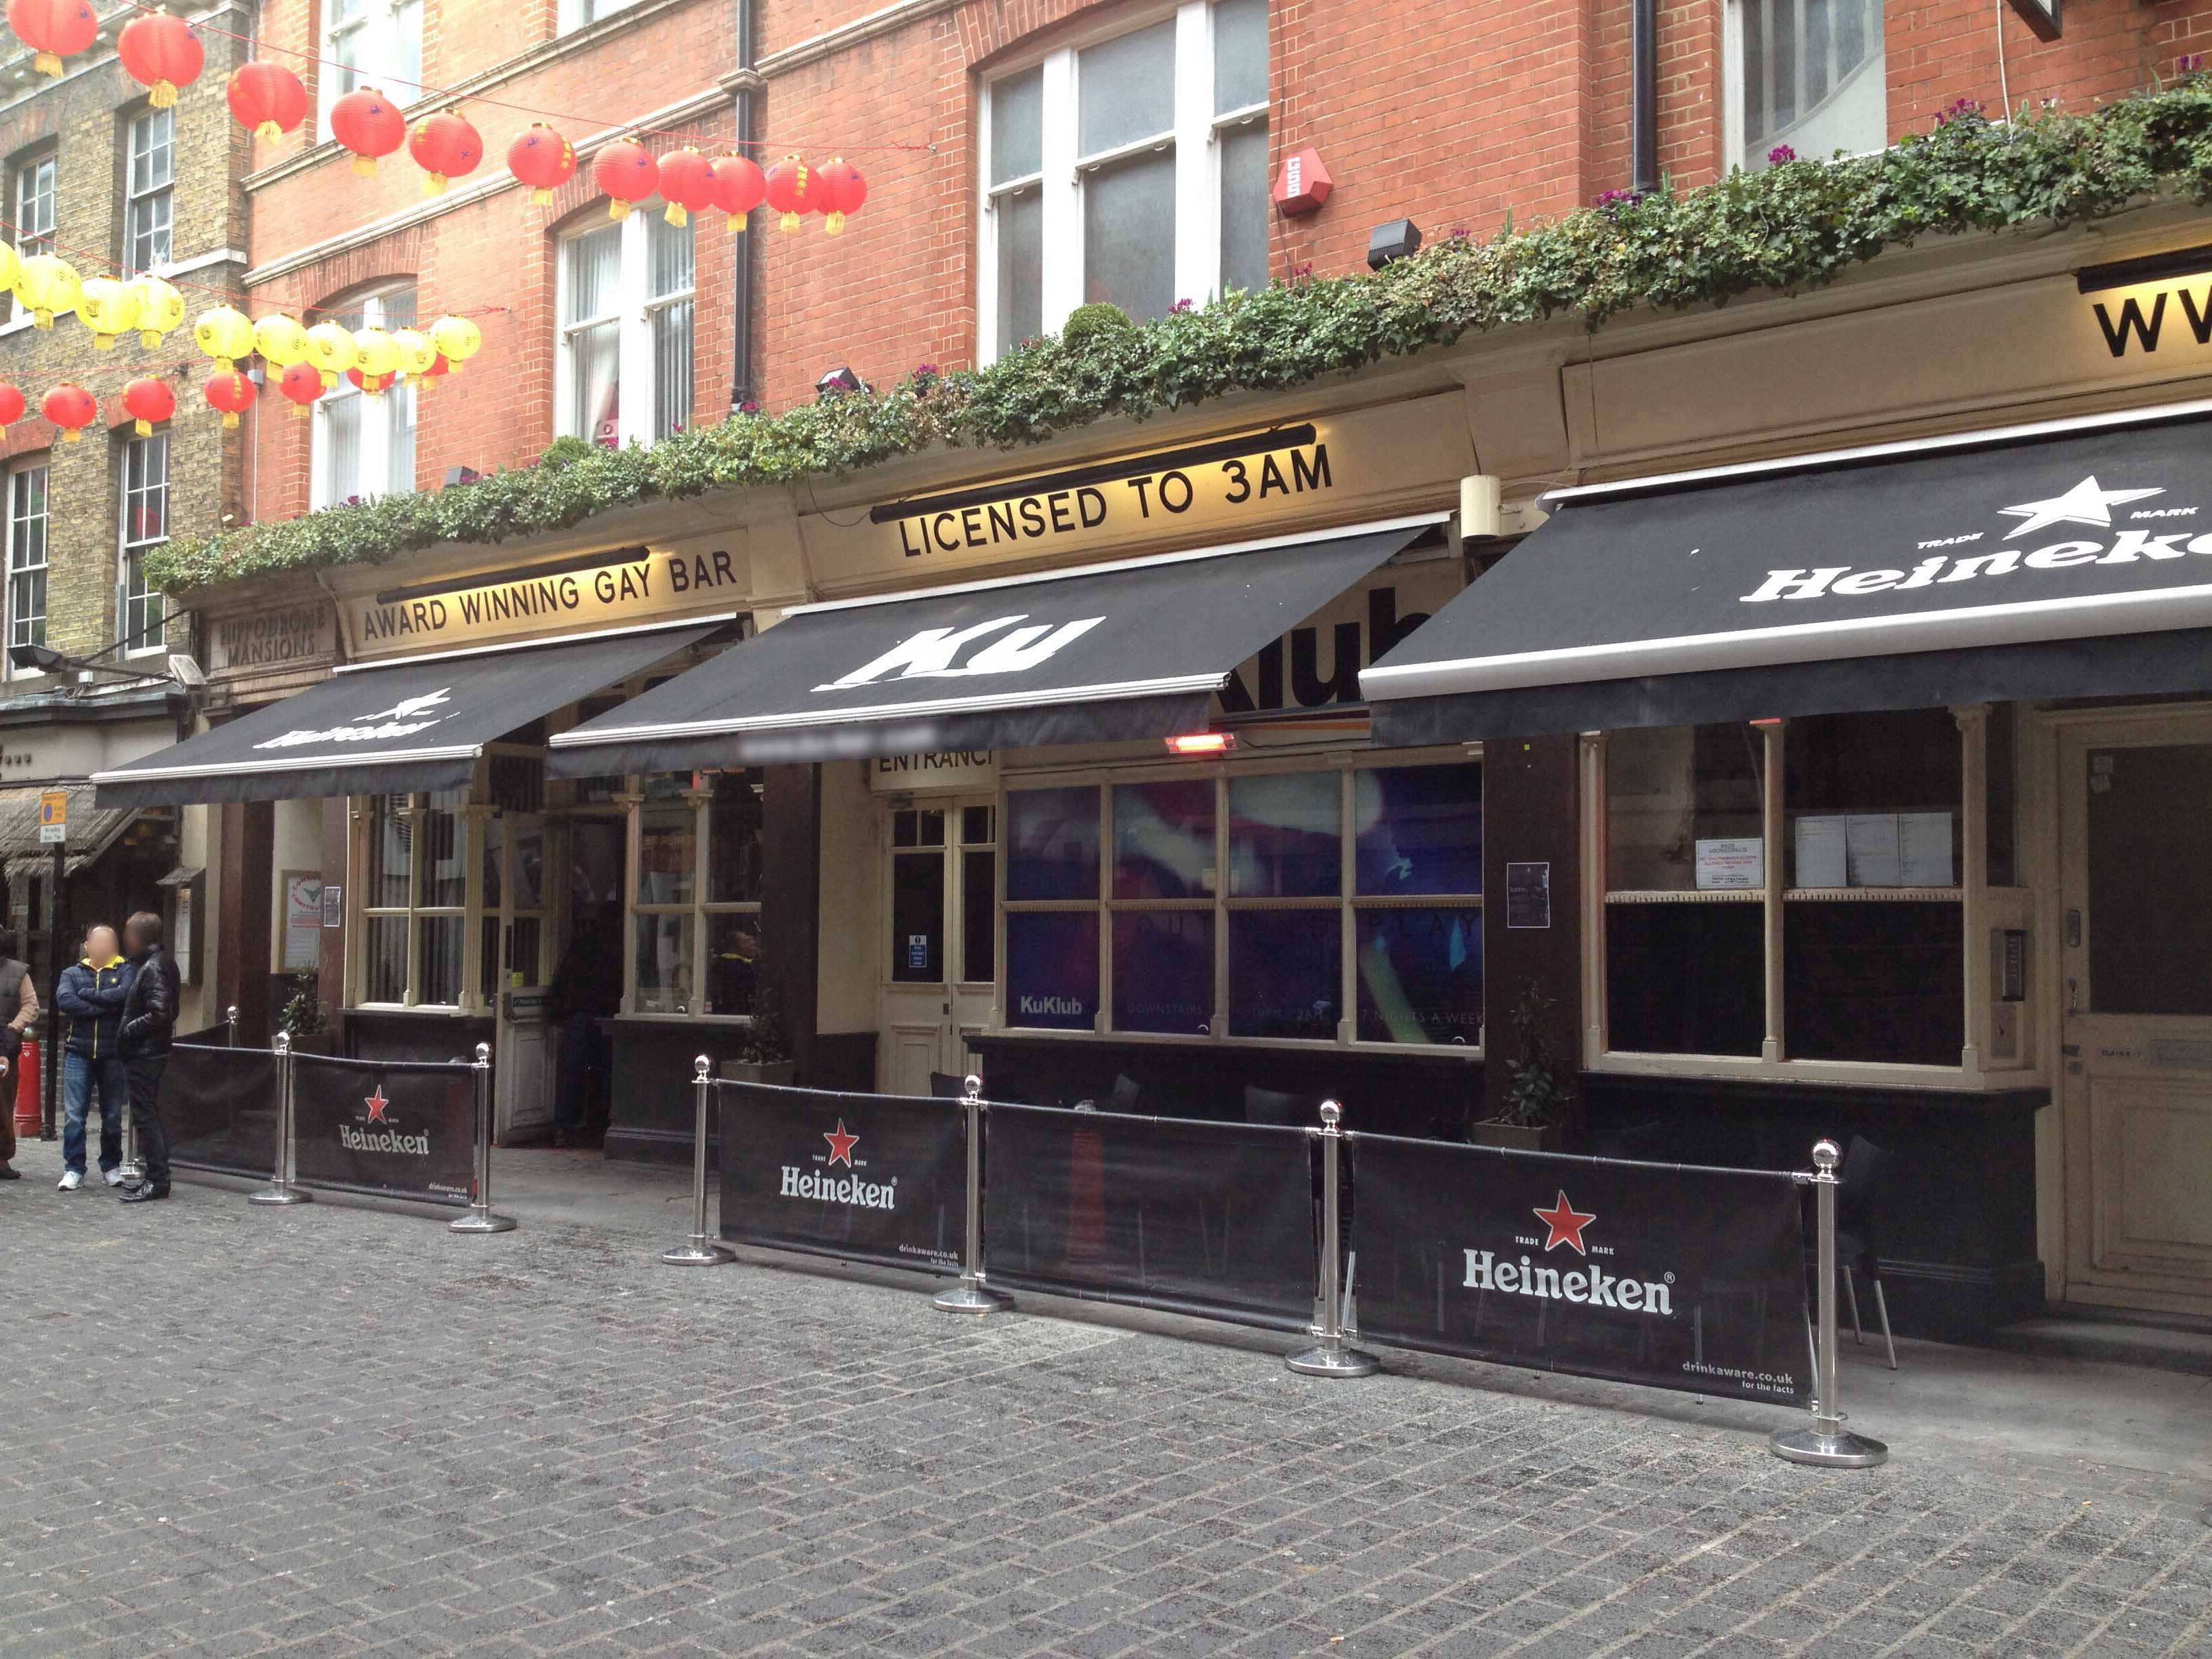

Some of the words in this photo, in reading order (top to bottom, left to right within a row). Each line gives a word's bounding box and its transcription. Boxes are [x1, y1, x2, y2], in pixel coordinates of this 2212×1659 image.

[898, 487, 1107, 558] LICENSED
[1128, 470, 1193, 518] TO
[1221, 443, 1333, 504] 3AM
[1917, 532, 1985, 550] TRADE
[2130, 506, 2200, 520] MARK
[363, 599, 447, 641] AWARD
[458, 576, 580, 626] WINNING
[594, 562, 651, 605] GAY
[668, 550, 738, 594] BAR
[227, 634, 315, 668] MANSIONS
[1217, 587, 1432, 714] lub
[879, 750, 992, 773] ENTRANC
[1020, 996, 1084, 1015] KuKlub
[1431, 1013, 1441, 1025] A
[339, 1124, 430, 1155] Heineken
[780, 1165, 895, 1210] Heineken
[899, 1244, 959, 1260] drinkaware.co.uk
[1515, 1235, 1540, 1246] TRADE
[1591, 1245, 1615, 1255] MARK
[1462, 1248, 1673, 1315] Heineken
[1682, 1361, 1794, 1385] drinkaware.co.uk
[1742, 1380, 1755, 1389] for
[1757, 1382, 1771, 1392] the
[1773, 1384, 1795, 1395] facts
